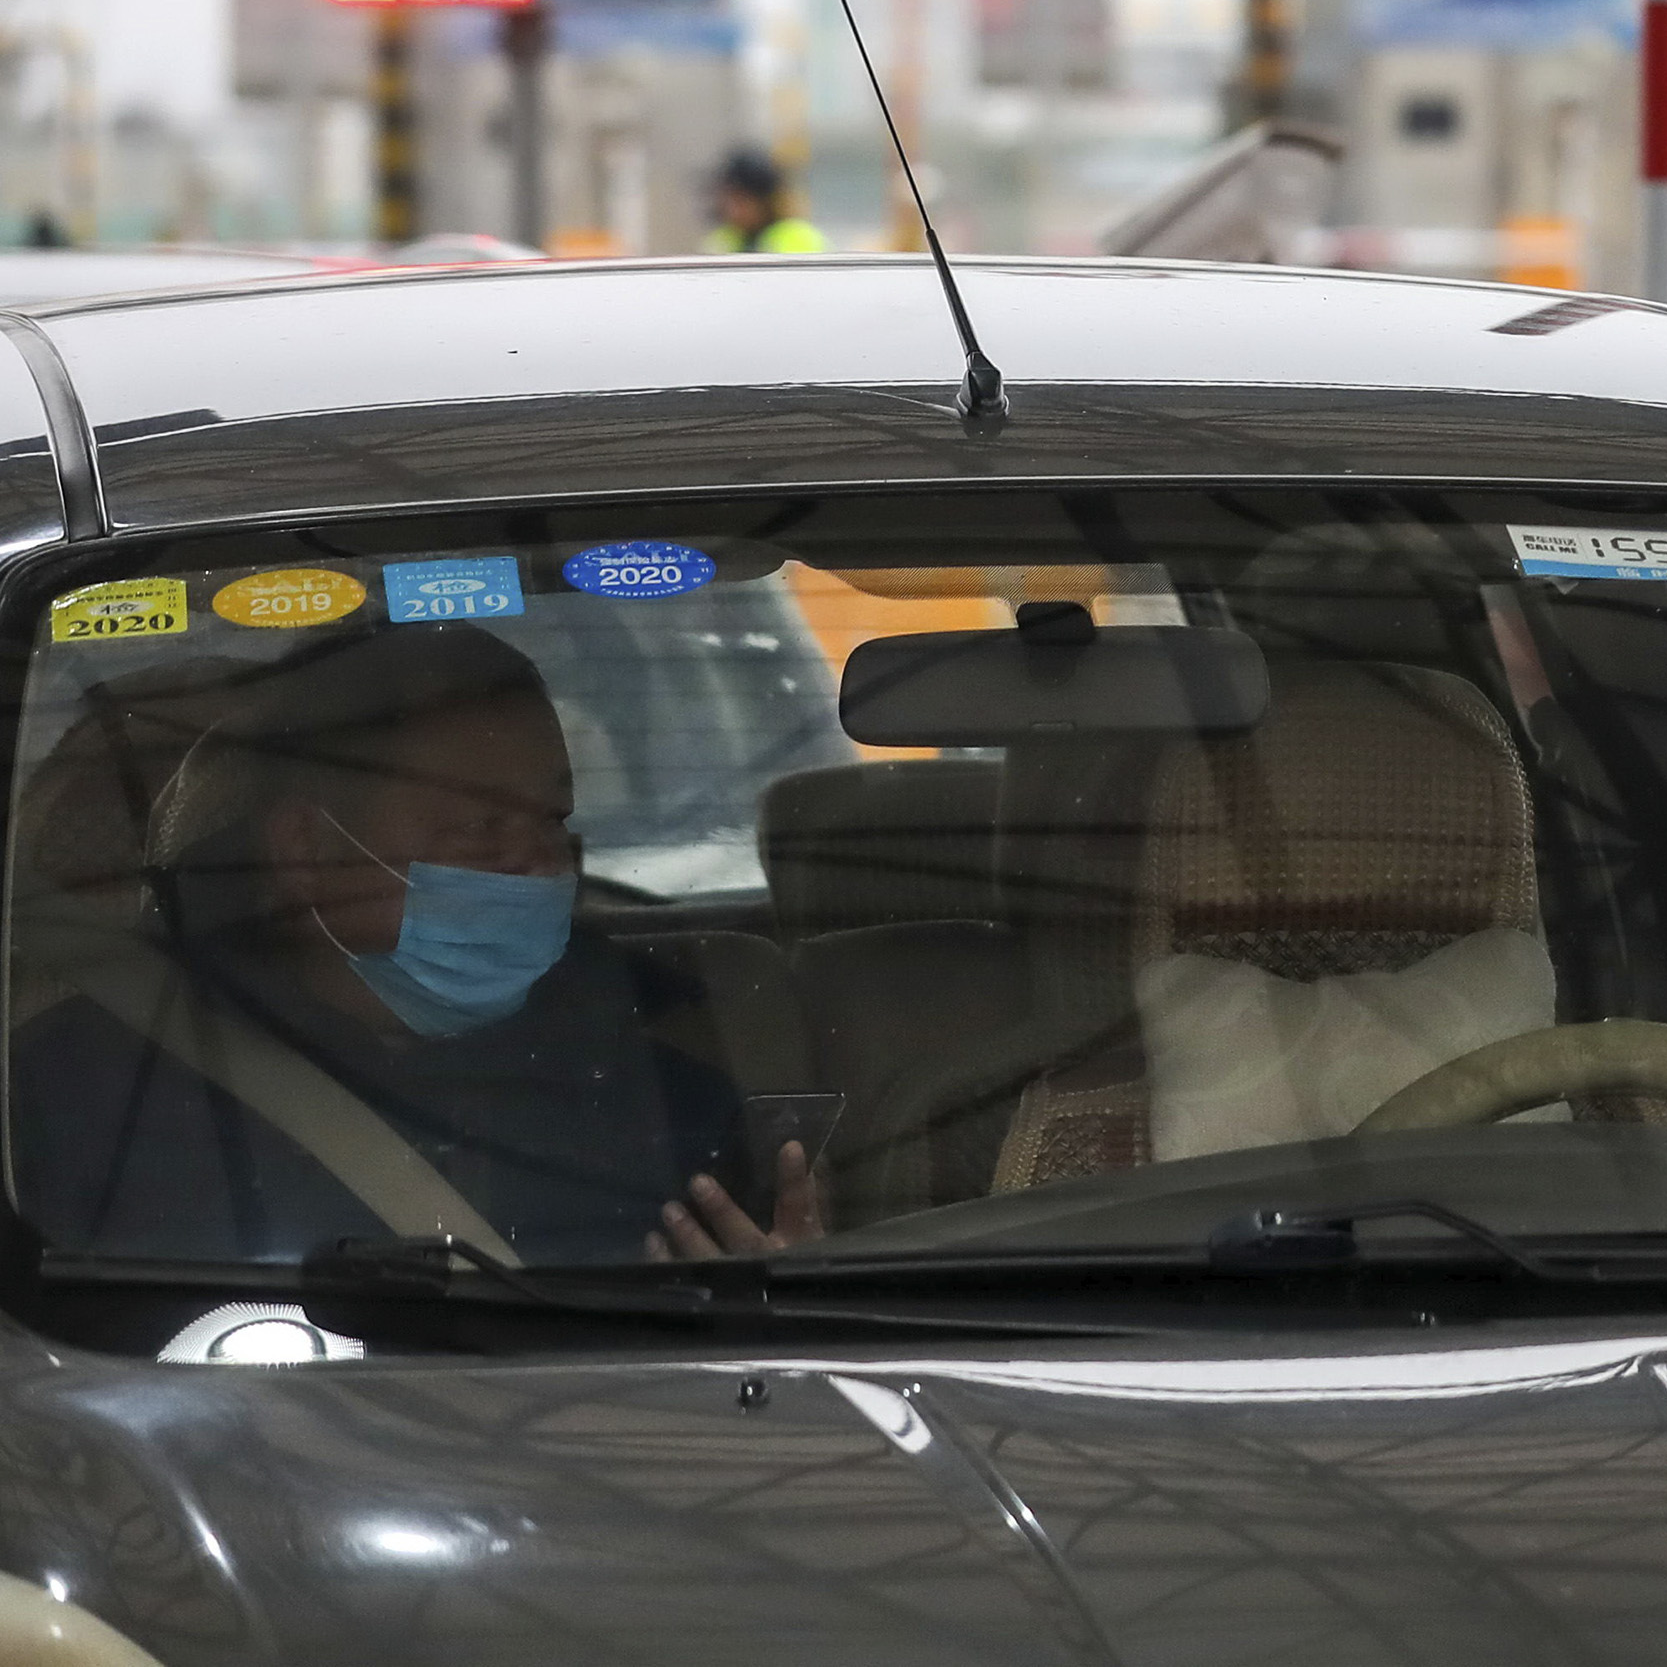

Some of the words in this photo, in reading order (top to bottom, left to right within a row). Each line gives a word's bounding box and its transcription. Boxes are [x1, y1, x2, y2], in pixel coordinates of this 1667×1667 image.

[1525, 542, 1557, 554] CALL
[1558, 545, 1579, 555] ME
[598, 565, 683, 586] 2020
[250, 592, 332, 616] 2019
[402, 593, 510, 619] 2019
[66, 613, 175, 638] 2020
